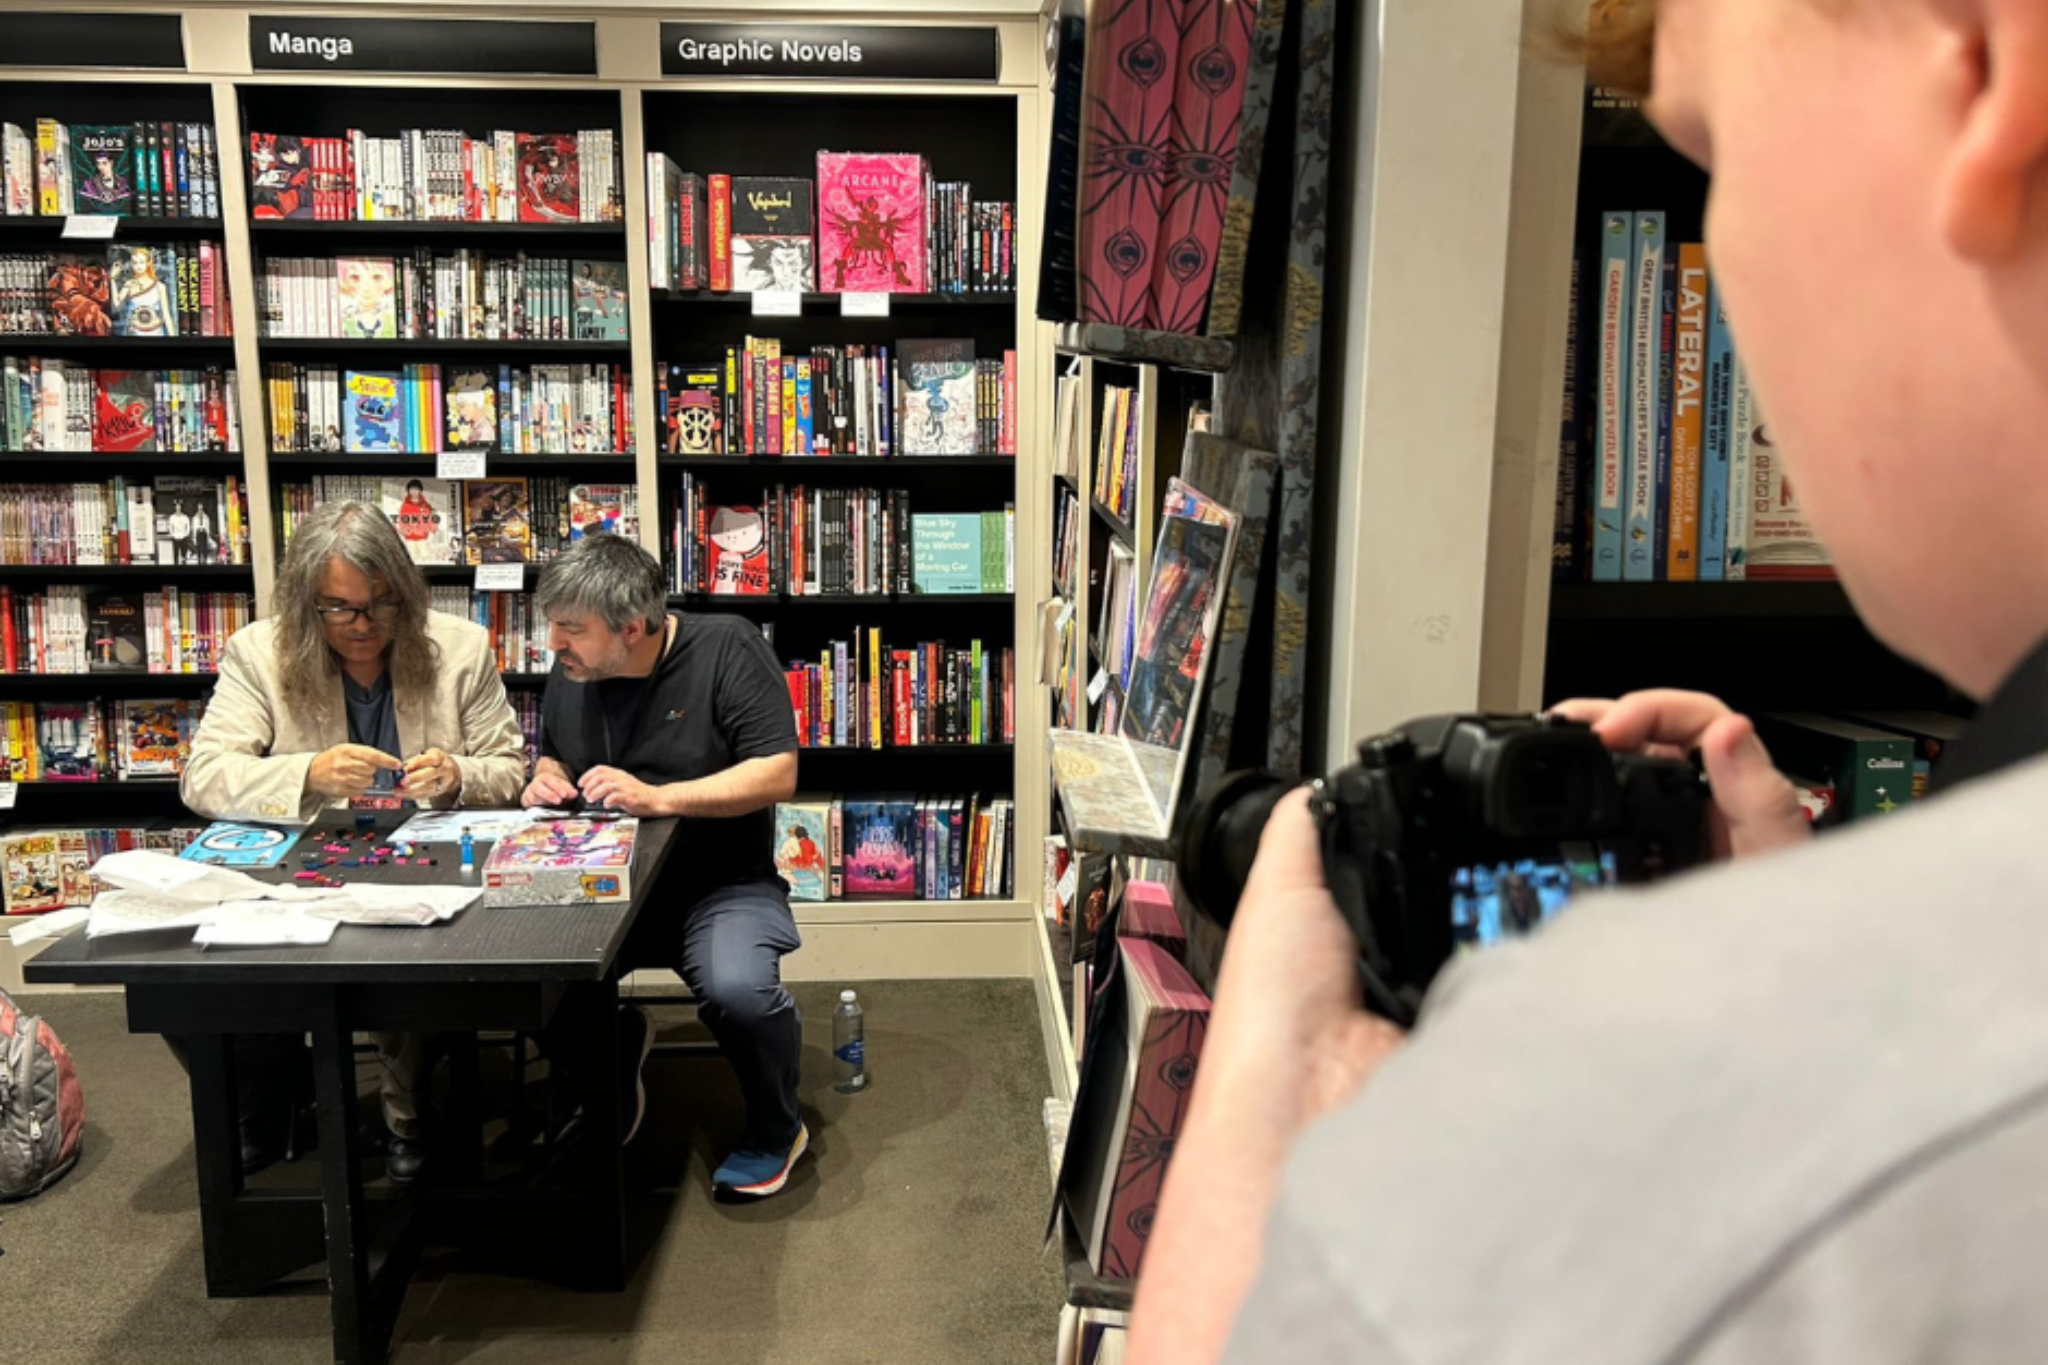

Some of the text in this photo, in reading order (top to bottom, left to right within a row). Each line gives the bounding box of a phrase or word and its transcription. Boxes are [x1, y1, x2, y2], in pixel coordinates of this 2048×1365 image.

[269, 32, 353, 60] Manga
[678, 39, 863, 66] Graphic Novels
[840, 173, 899, 188] ARCANE
[1677, 268, 1704, 416] LATERAL
[1604, 270, 1621, 498] GARDEN BIRDWATCHER'S PUZZLE BOOK
[1635, 258, 1655, 507] GREAT BRITISH BIRDWATCHER'S PUZZLE BOOK
[1721, 375, 1729, 406] TRIVIA
[1708, 362, 1720, 452] MANCHESTER CITY
[1737, 388, 1749, 429] Puzzle
[1718, 408, 1727, 462] QUESTIONS
[1736, 431, 1748, 463] Book
[1672, 427, 1685, 540] DAVID BODYCOMBE
[1685, 446, 1696, 523] TOM SCOTT &
[915, 518, 957, 529] Blue Sky
[915, 530, 956, 541] Through
[915, 541, 971, 550] the Window
[915, 553, 926, 561] of
[732, 570, 765, 588] FINE
[915, 563, 968, 573] Moving Car
[1866, 757, 1905, 769] Collins
